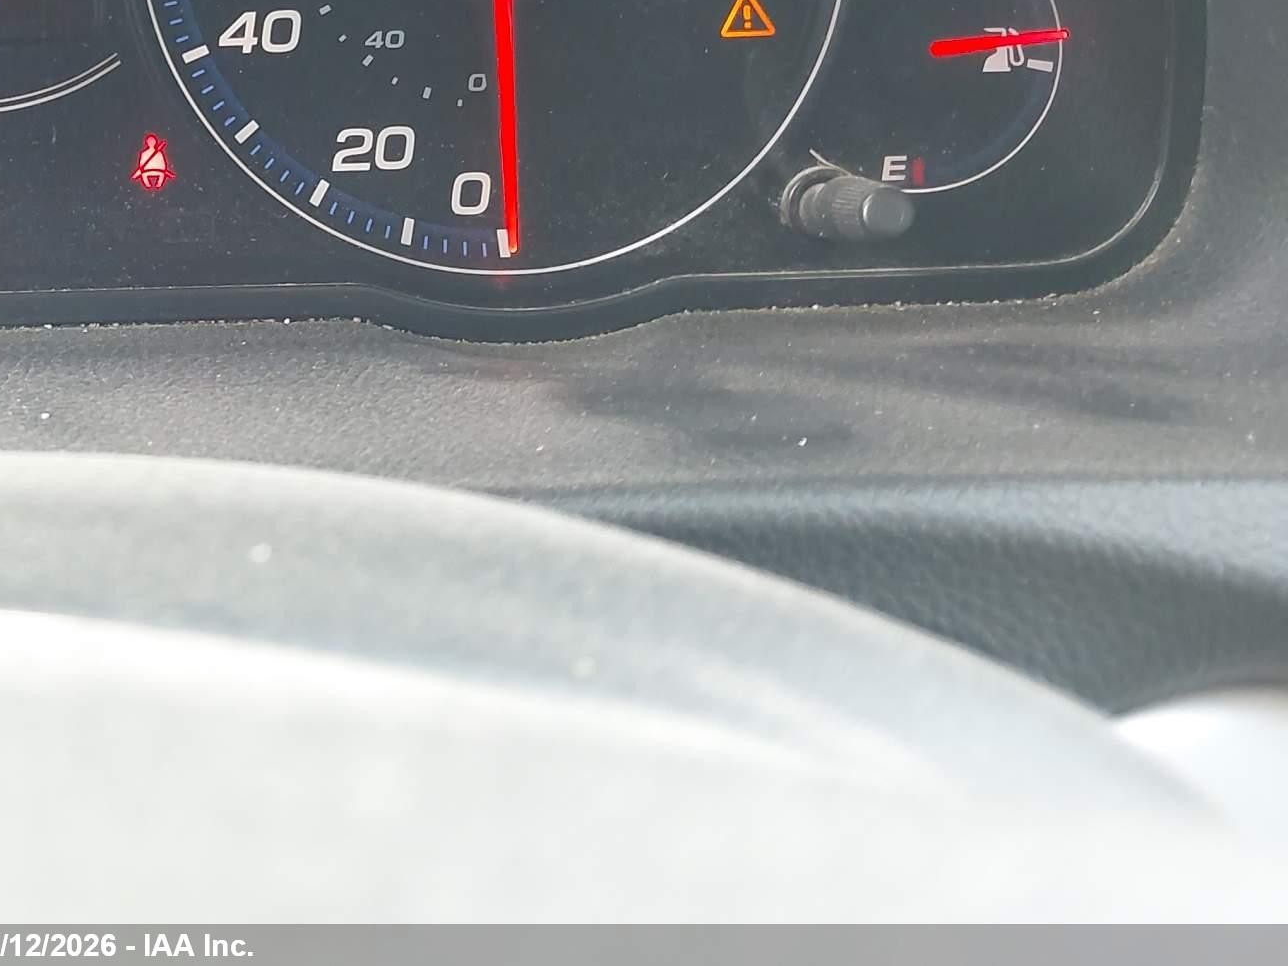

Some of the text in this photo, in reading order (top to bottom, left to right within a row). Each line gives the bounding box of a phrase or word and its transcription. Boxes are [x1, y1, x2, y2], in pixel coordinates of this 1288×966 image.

[218, 9, 302, 54] 40
[365, 30, 405, 50] 40
[468, 73, 487, 92] 0
[331, 125, 415, 171] 20
[881, 155, 907, 181] E
[450, 171, 491, 215] 0
